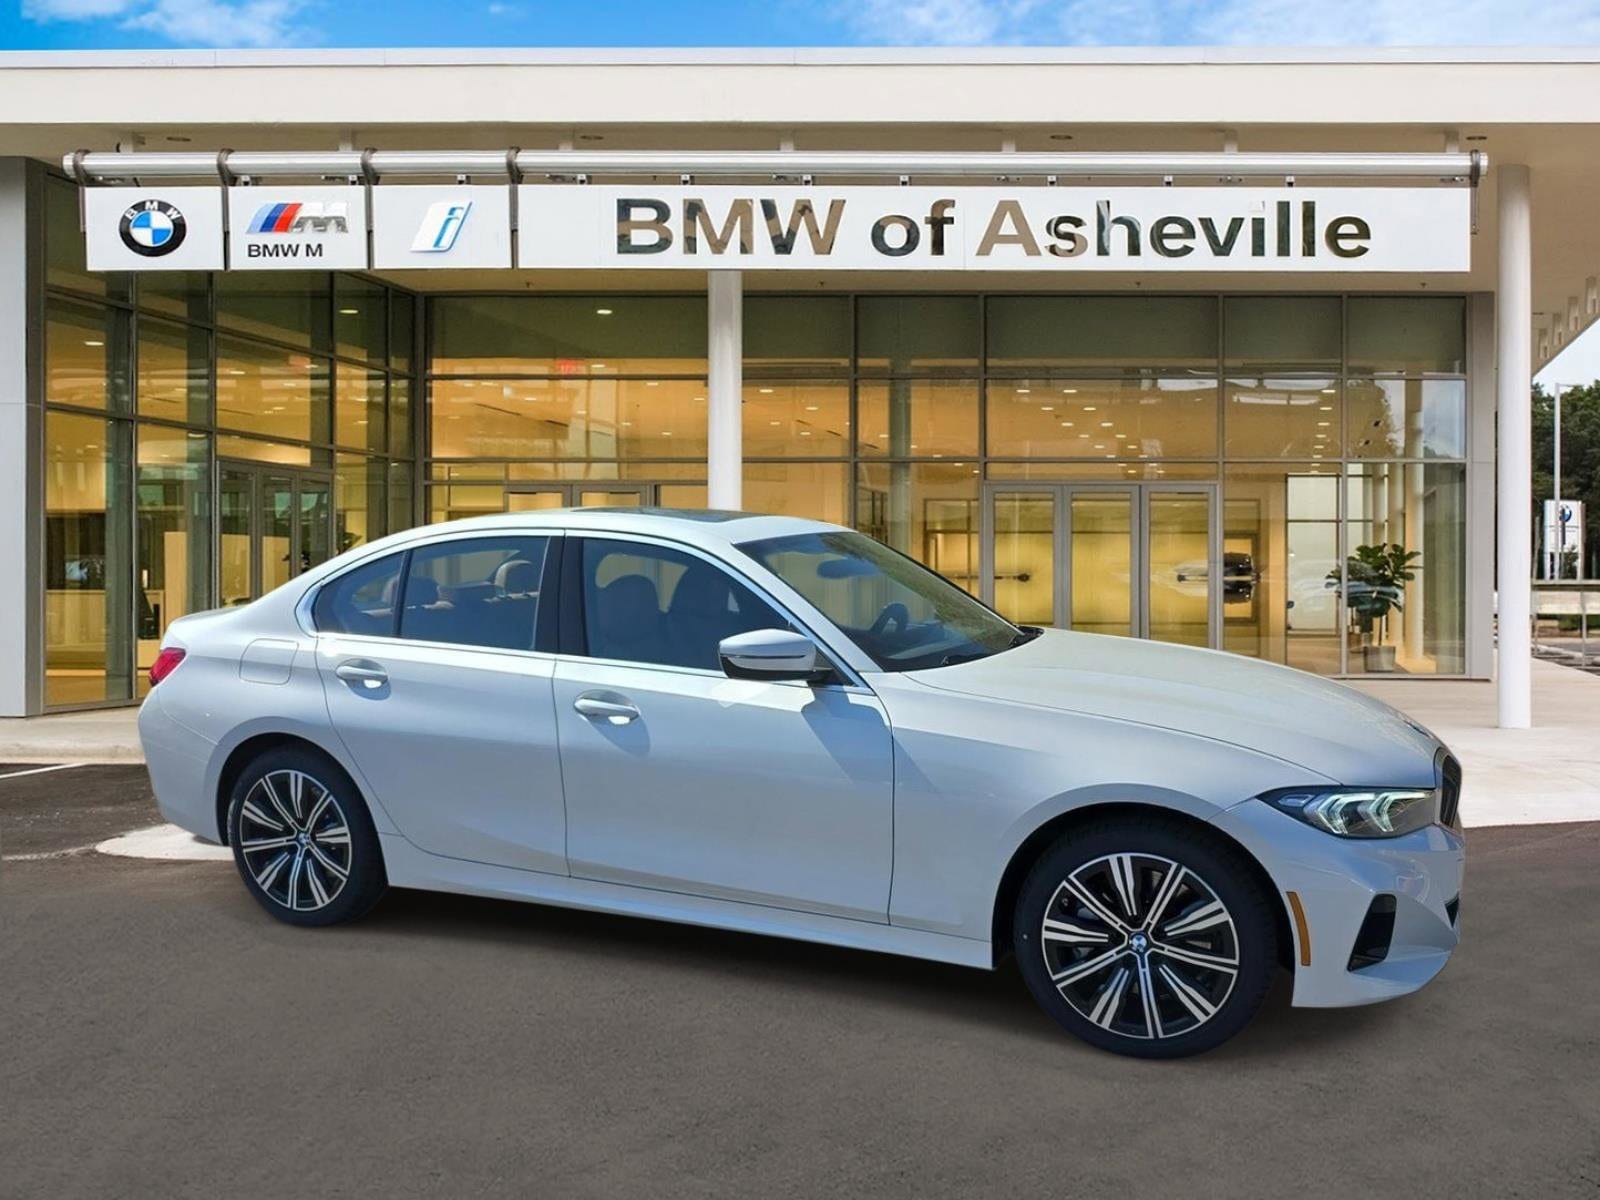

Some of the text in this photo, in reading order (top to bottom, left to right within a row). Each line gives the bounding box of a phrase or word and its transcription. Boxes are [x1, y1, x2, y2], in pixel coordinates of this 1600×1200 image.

[125, 201, 181, 220] BMW
[616, 198, 1371, 257] BMW of Asheville
[247, 243, 323, 257] BMW M
